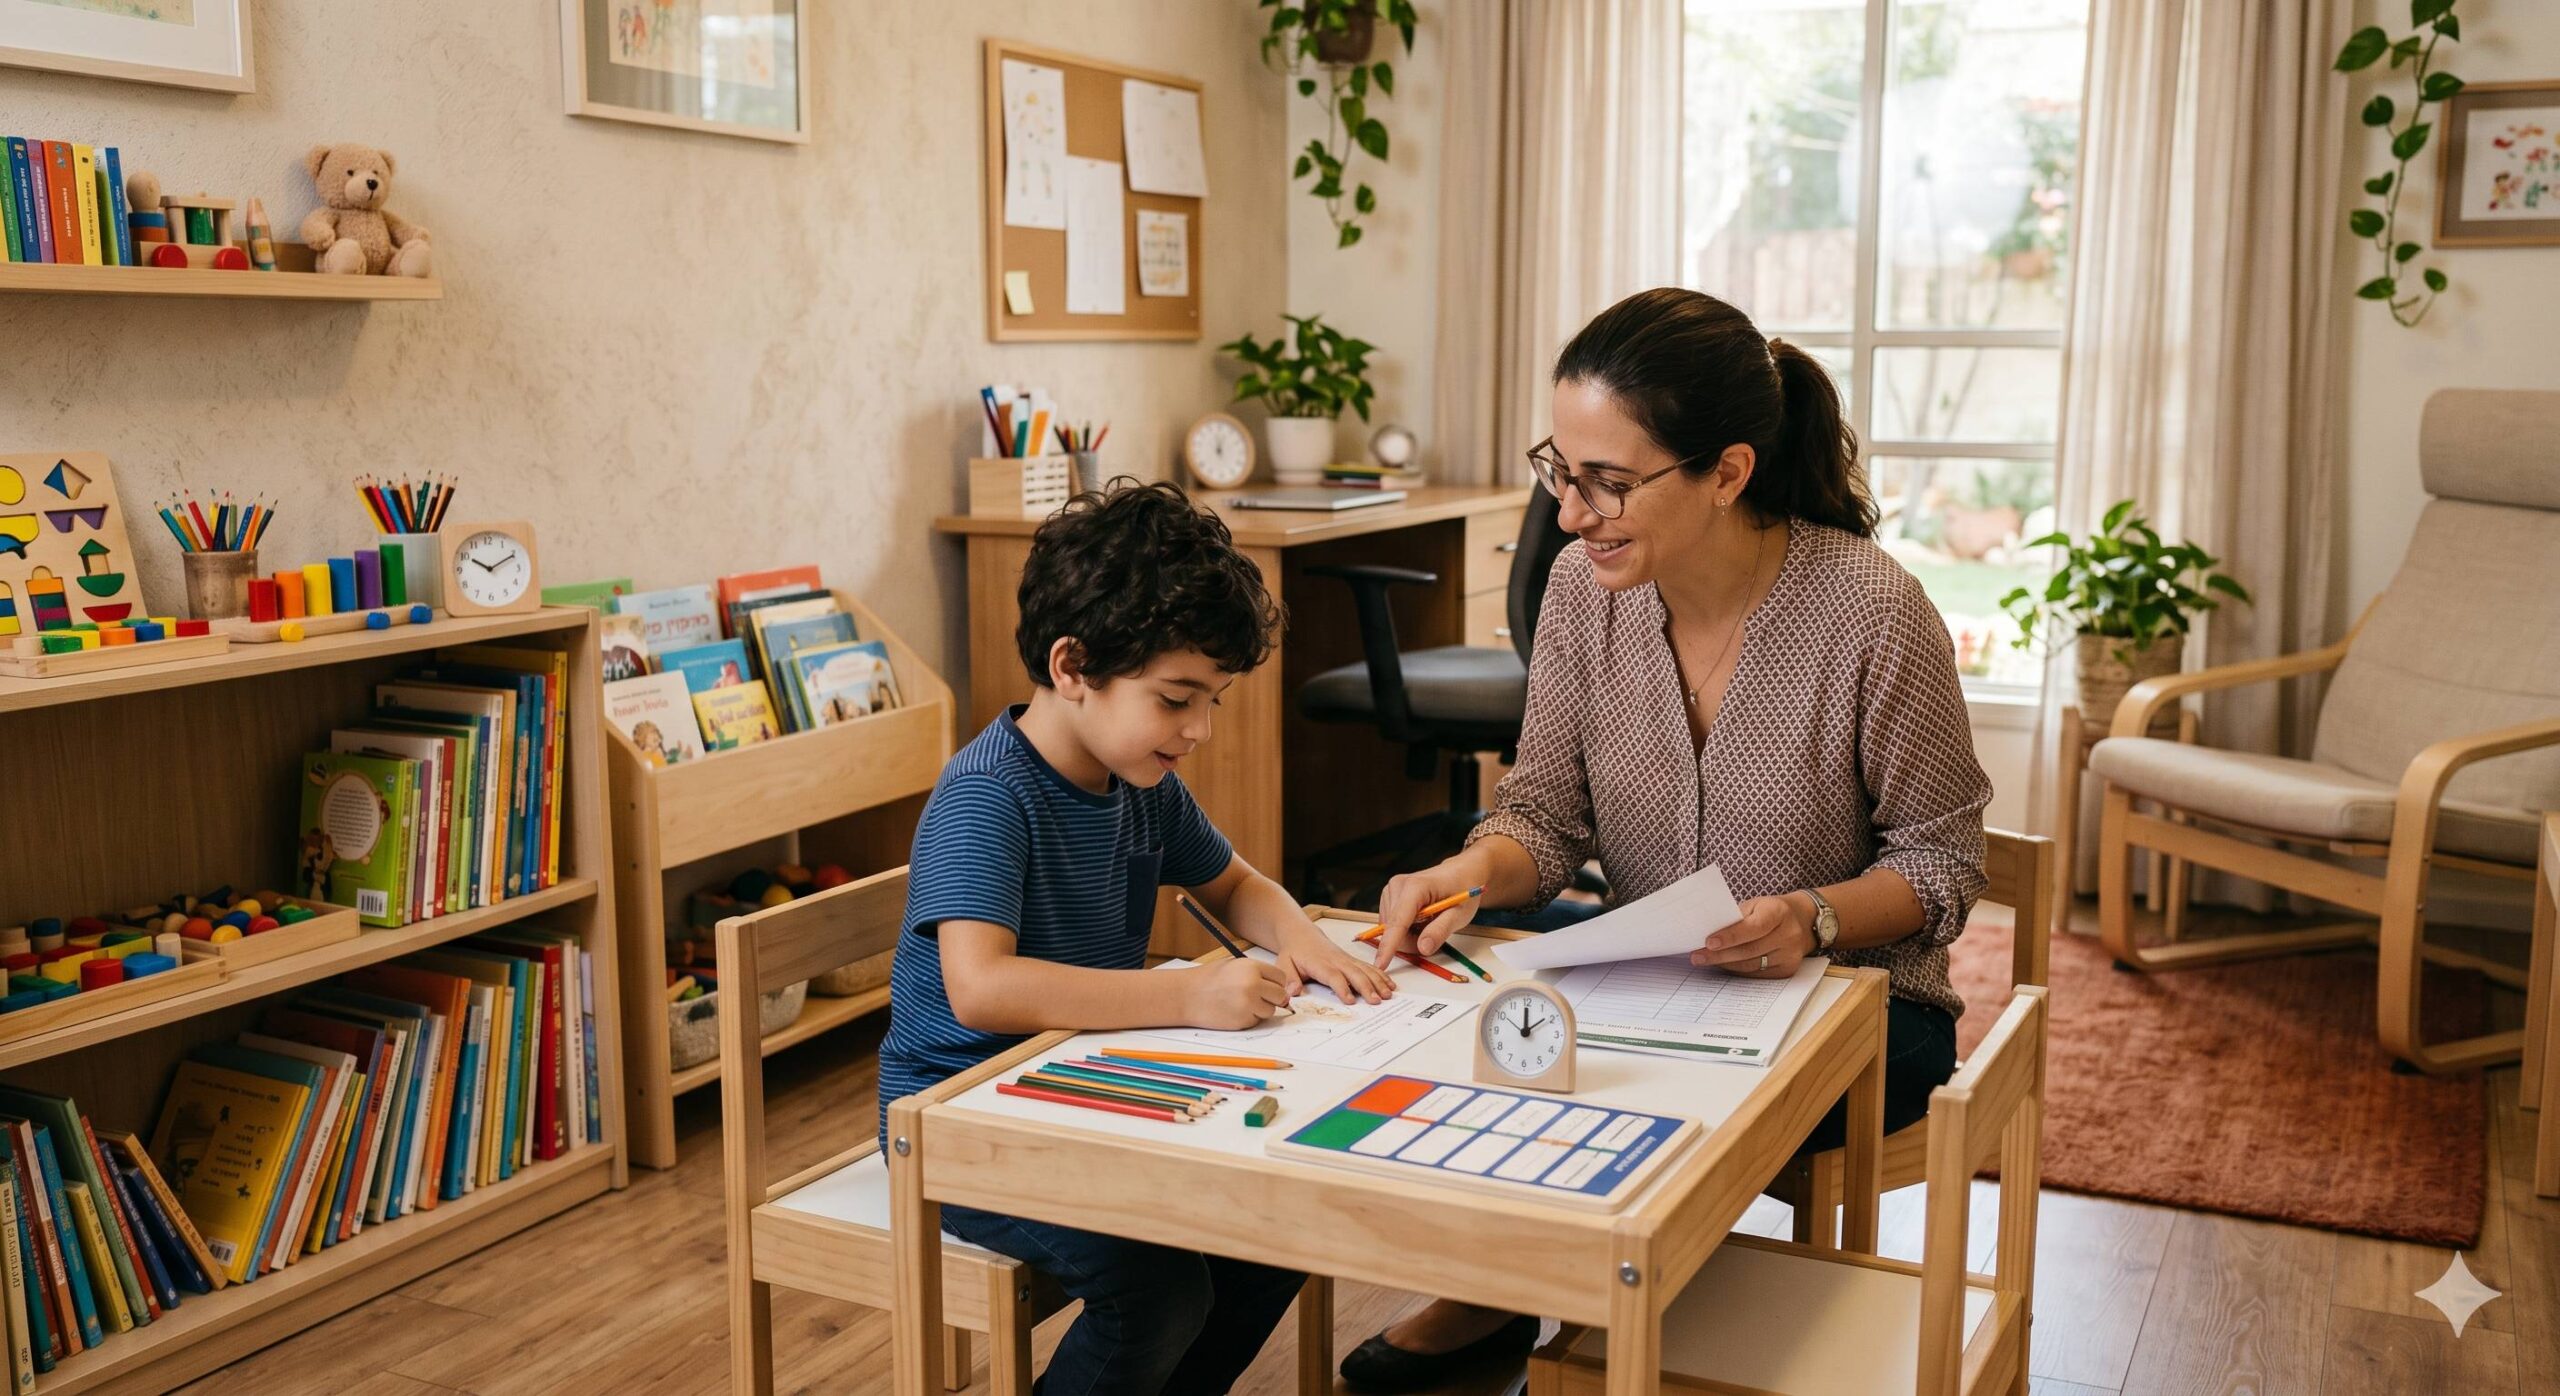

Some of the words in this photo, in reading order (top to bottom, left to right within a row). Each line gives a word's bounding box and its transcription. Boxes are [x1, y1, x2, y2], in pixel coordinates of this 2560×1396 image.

[484, 536, 492, 545] 12
[470, 541, 477, 549] 11
[460, 552, 470, 561] 10
[462, 580, 468, 589] 8
[475, 590, 480, 599] 7
[488, 593, 494, 601] 6
[1510, 1002, 1516, 1010] 11
[1523, 998, 1532, 1007] 12
[1497, 1011, 1506, 1020] 10
[1549, 1015, 1555, 1024] 2
[1494, 1026, 1499, 1034] 9
[1554, 1031, 1559, 1039] 3
[1497, 1042, 1503, 1050] 8
[1548, 1046, 1554, 1054] 4
[1508, 1054, 1513, 1062] 7
[1537, 1056, 1542, 1064] 5
[1522, 1060, 1526, 1068] 6
